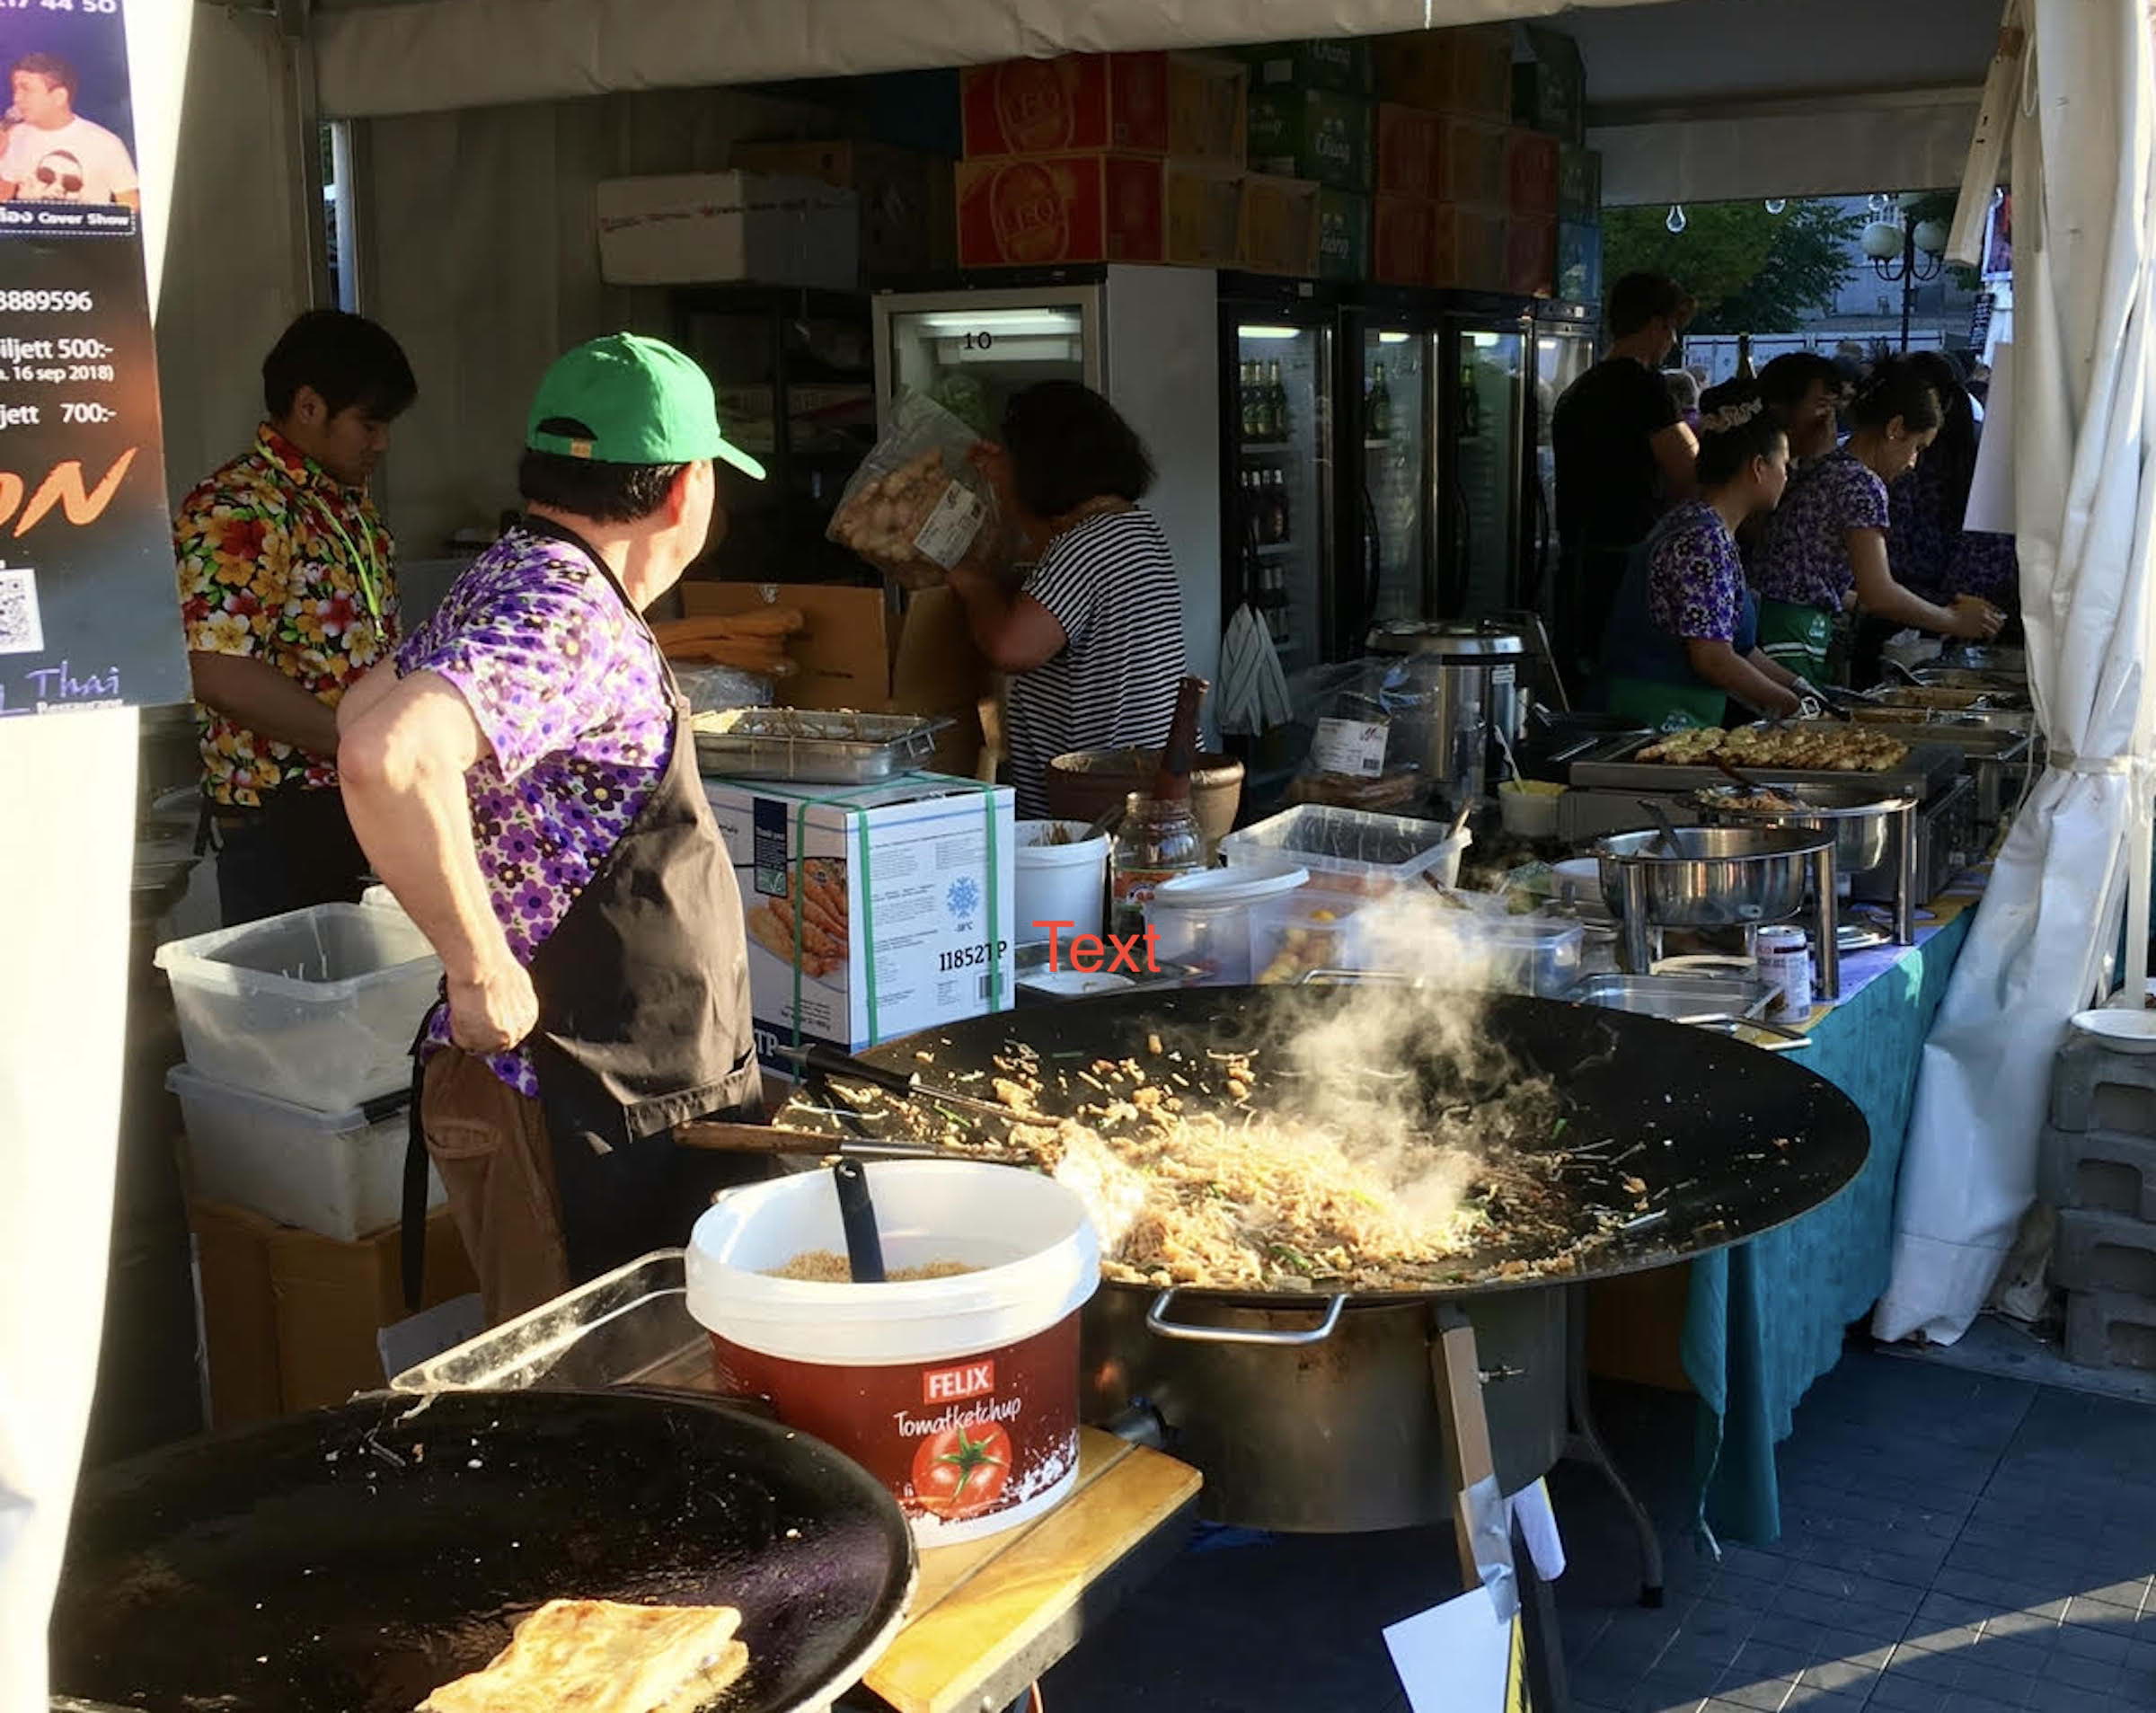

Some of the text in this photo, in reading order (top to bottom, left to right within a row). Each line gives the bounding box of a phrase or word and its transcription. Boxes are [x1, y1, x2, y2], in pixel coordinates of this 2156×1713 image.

[83, 0, 118, 13] 50
[39, 212, 84, 225] Cover
[87, 213, 130, 225] Show
[964, 331, 992, 349] 10
[0, 338, 113, 364] iljett 500:-
[13, 366, 34, 381] 16
[36, 368, 66, 384] sep
[68, 365, 114, 382] 2018)
[60, 403, 117, 423] 700:-
[25, 660, 119, 698] Thai
[929, 1365, 989, 1398] FELIX
[893, 1397, 1021, 1437] Tomatketchup
